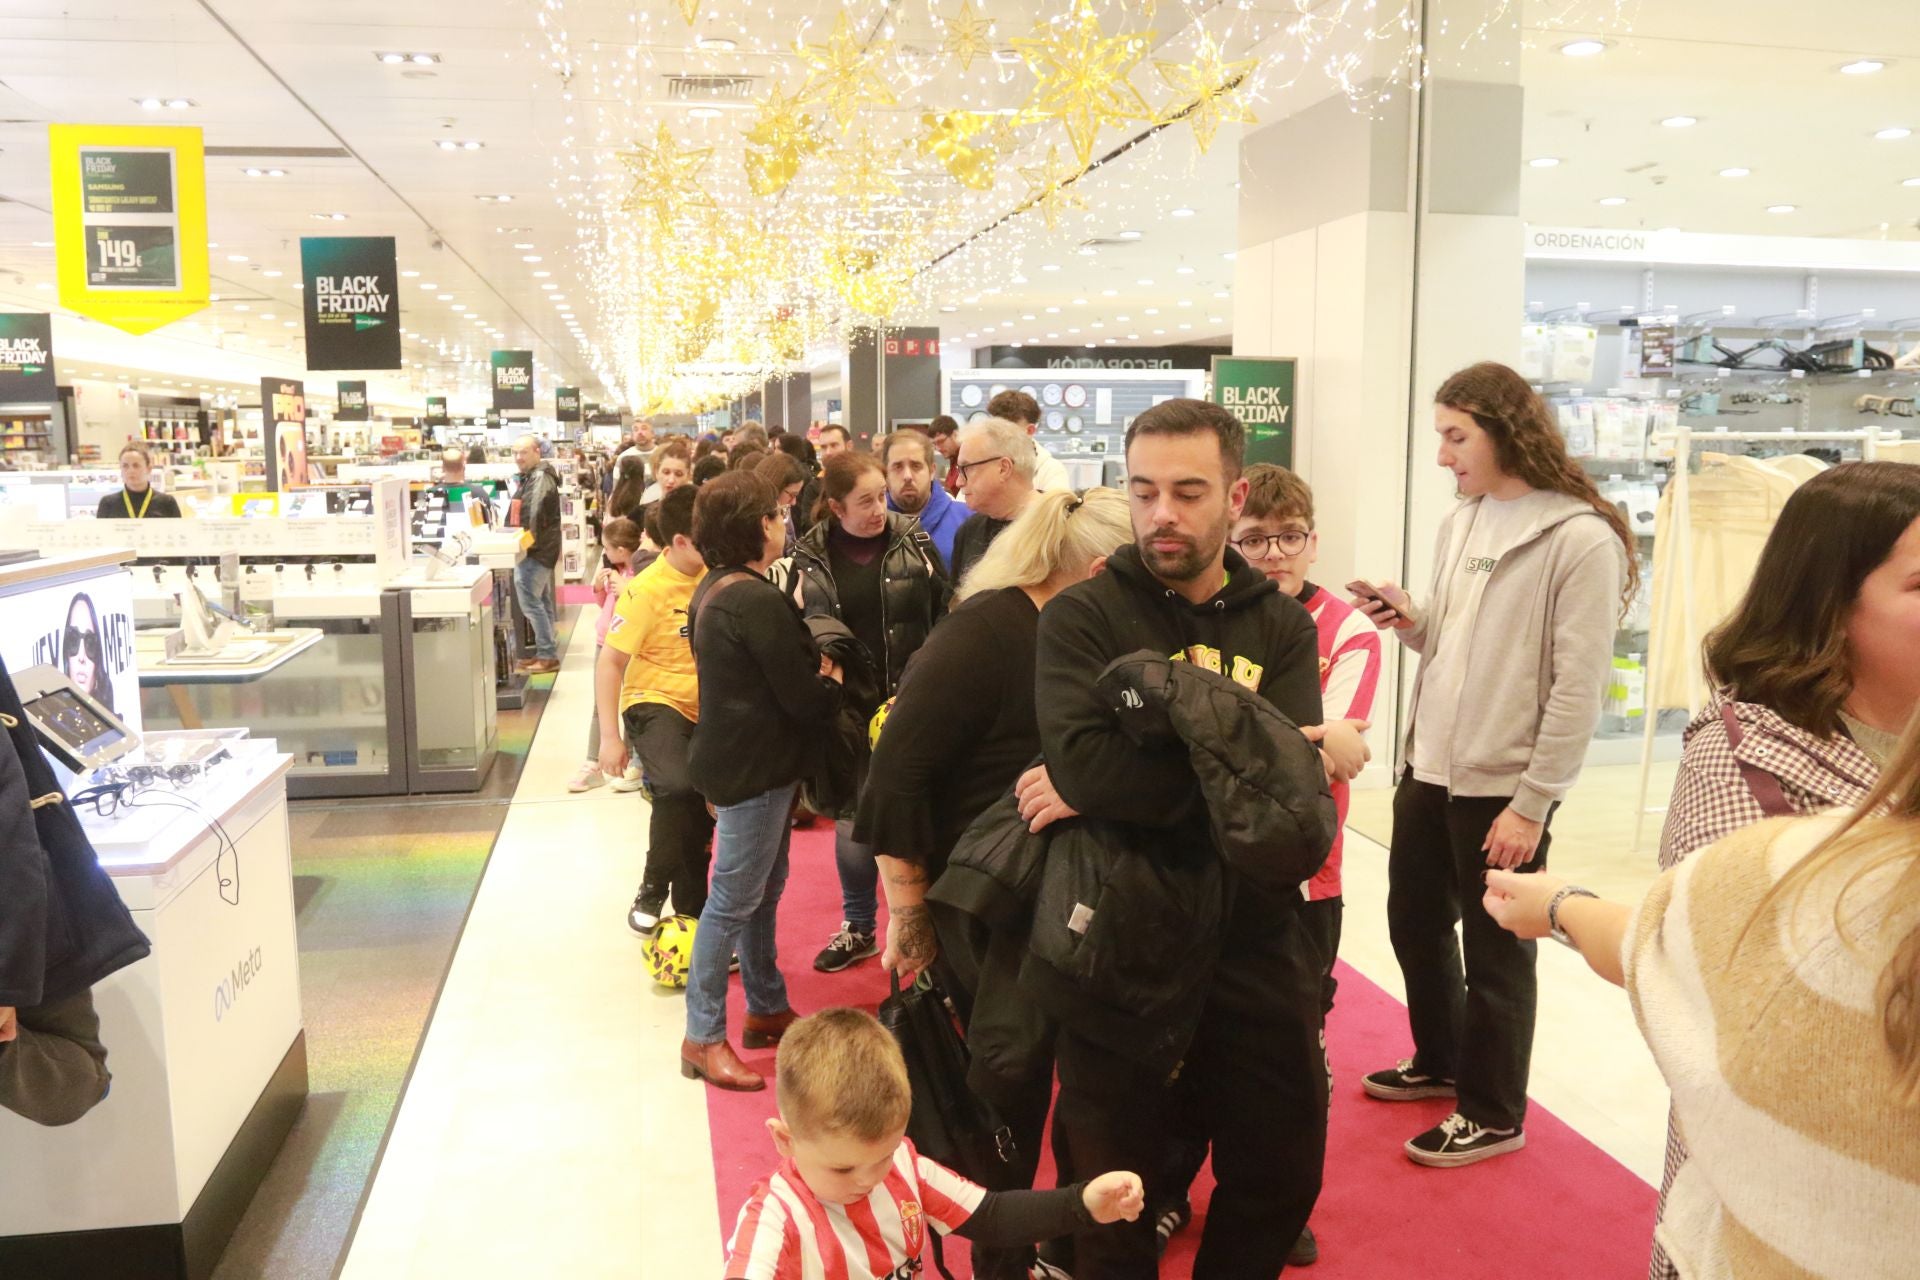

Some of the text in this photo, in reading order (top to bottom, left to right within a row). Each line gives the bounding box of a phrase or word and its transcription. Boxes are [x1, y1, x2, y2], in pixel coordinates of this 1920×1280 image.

[85, 157, 112, 165] BLACK
[86, 165, 117, 173] FRIDAY
[1534, 232, 1645, 250] ORDENACIÓN
[316, 276, 380, 294] BLACK
[317, 294, 390, 312] FRIDAY
[496, 367, 526, 376] BLACK
[497, 375, 530, 385] FRIDAY
[1223, 387, 1280, 405] BLACK
[231, 944, 262, 1001] Meta
